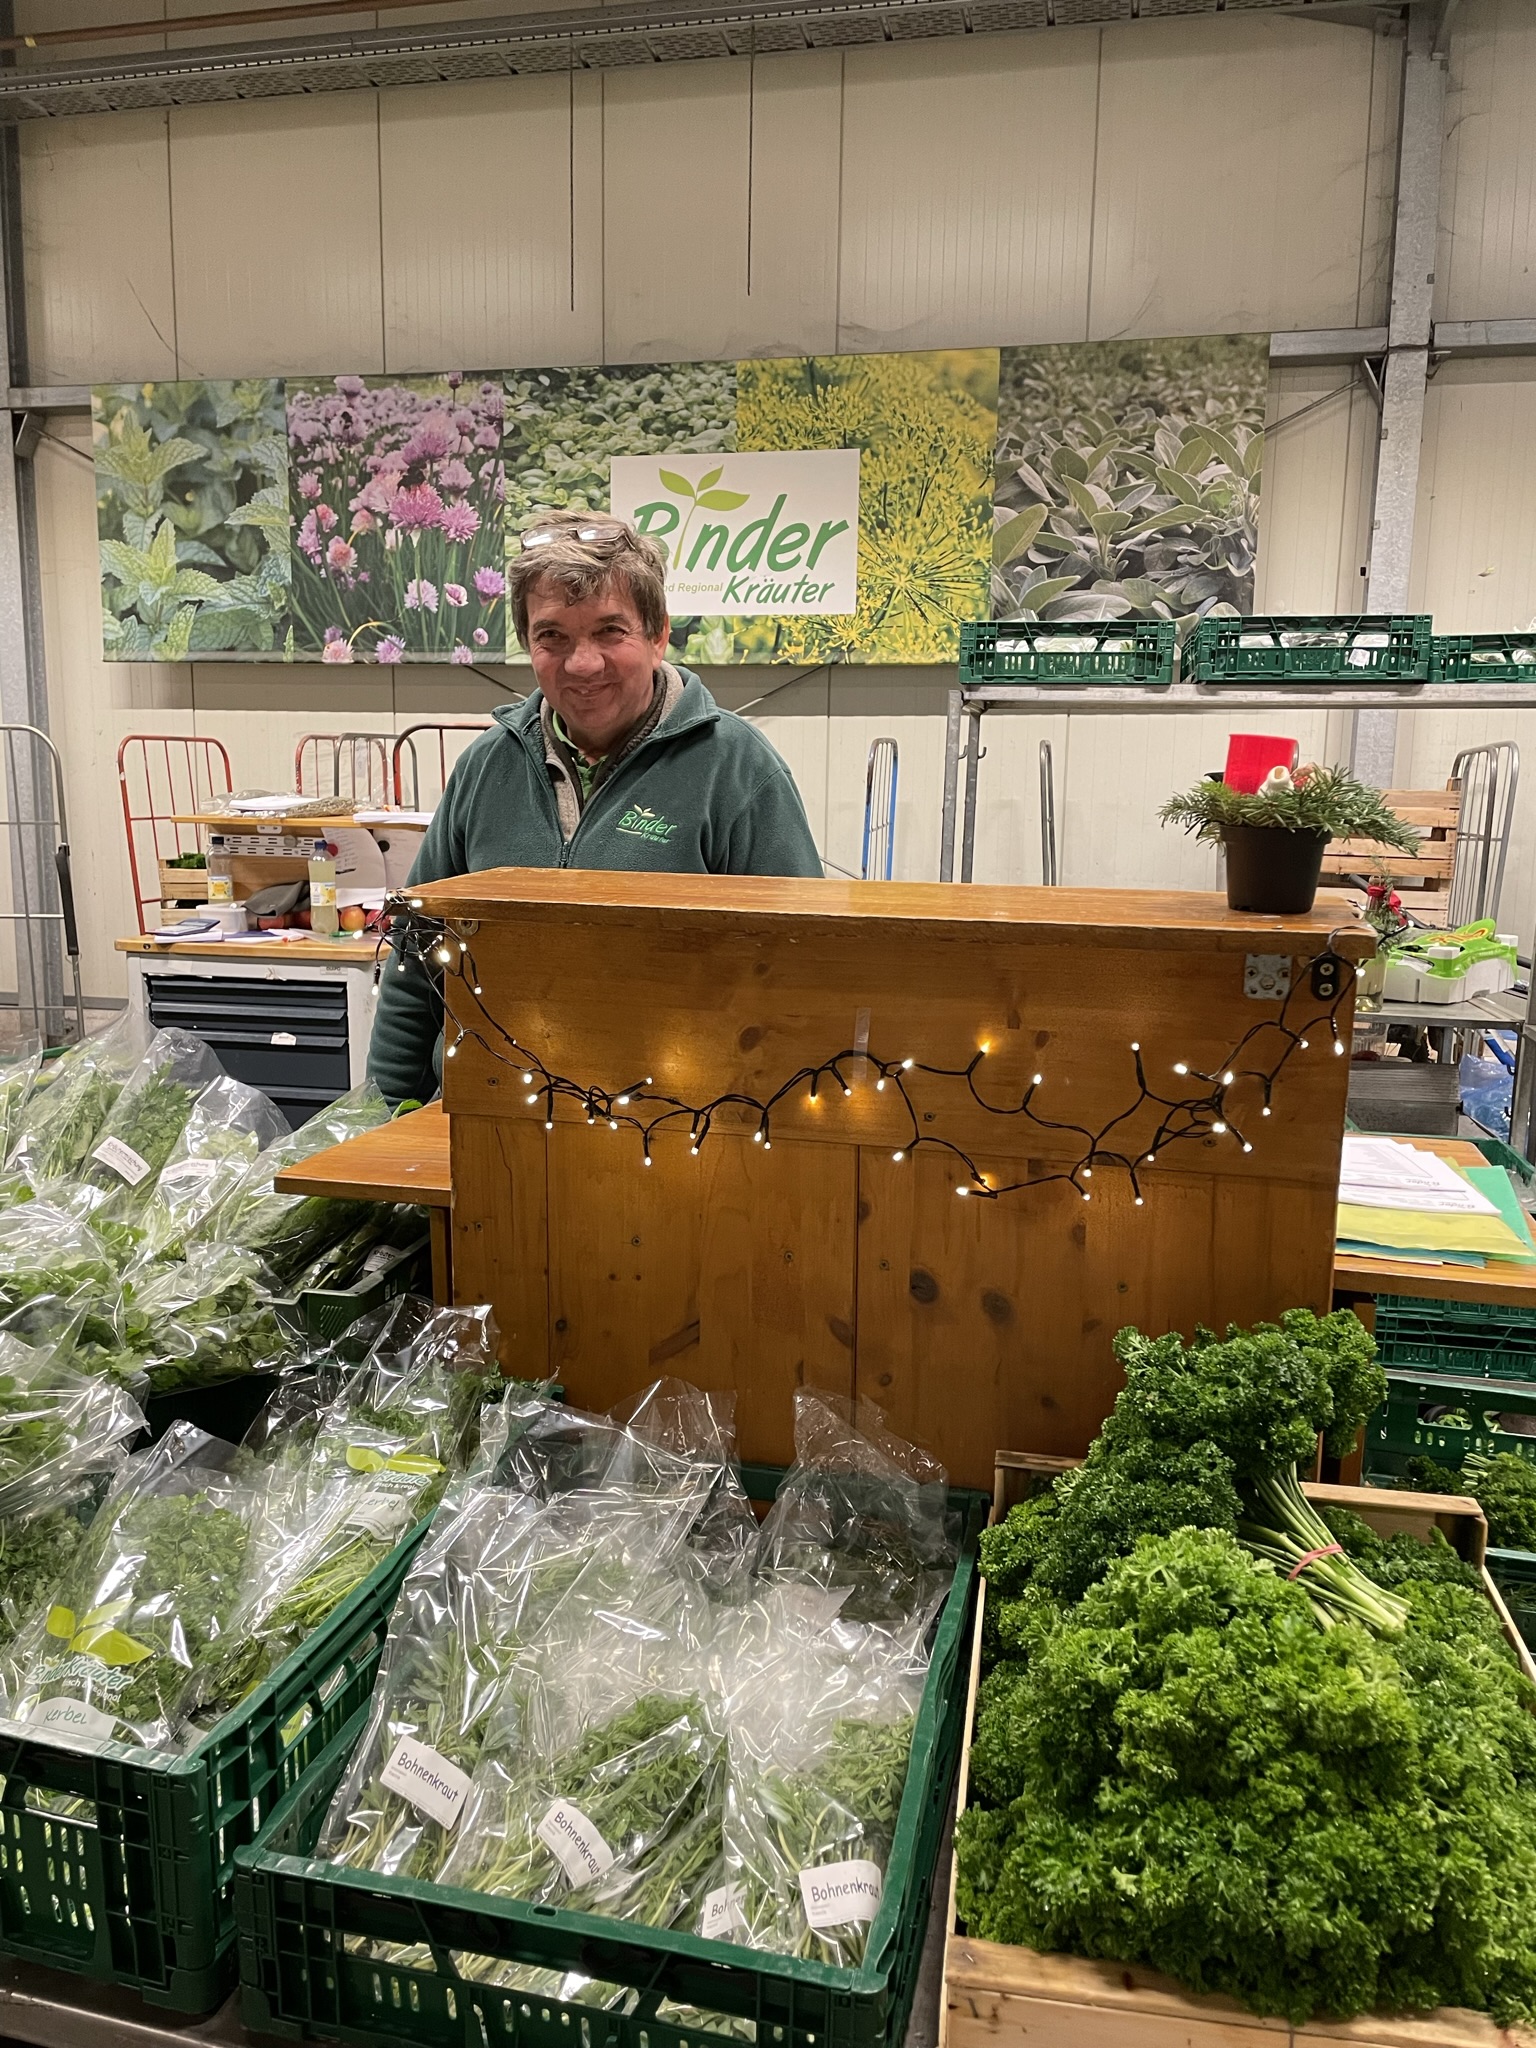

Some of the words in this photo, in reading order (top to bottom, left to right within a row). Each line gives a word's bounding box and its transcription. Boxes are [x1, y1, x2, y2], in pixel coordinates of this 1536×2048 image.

[633, 493, 849, 573] Binder
[664, 583, 676, 592] nd
[678, 582, 724, 594] Regional
[721, 574, 836, 604] Kräuter
[618, 809, 678, 836] Binder
[91, 1684, 122, 1703] egional
[397, 1752, 459, 1802] Bohnenkraut
[554, 1811, 602, 1877] Bohnenkraut
